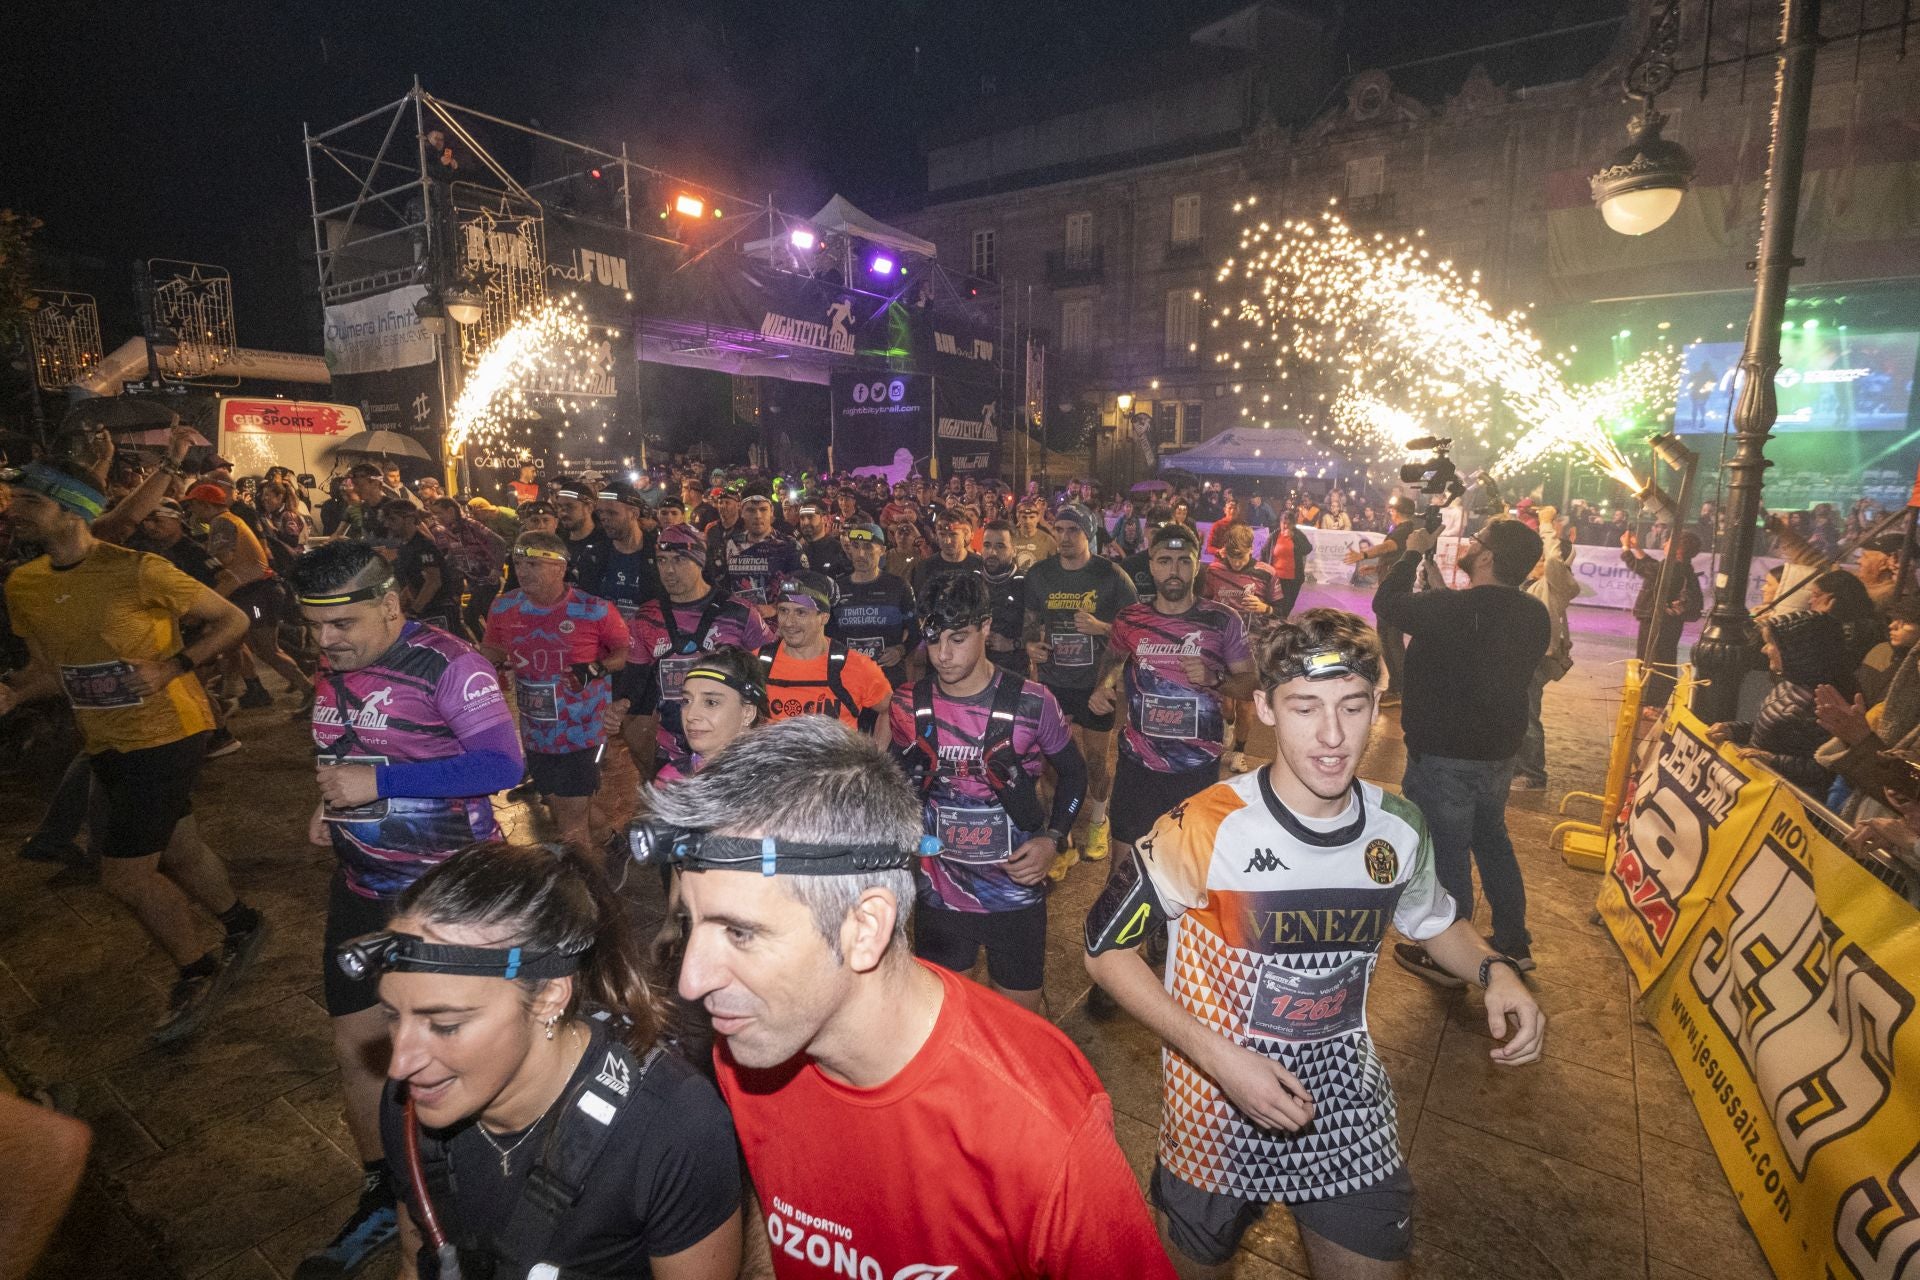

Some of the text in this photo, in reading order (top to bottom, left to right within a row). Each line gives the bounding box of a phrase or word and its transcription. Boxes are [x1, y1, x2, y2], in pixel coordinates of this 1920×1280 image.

[581, 248, 629, 290] FUN
[327, 321, 375, 341] Quimera
[761, 312, 856, 352] NIGHTCITY TRAIL
[843, 404, 920, 416] nightcitytrail.com
[938, 417, 982, 438] NIGHTCITY
[1049, 592, 1080, 600] adamo
[1136, 643, 1181, 655] NIGHTCITY
[357, 712, 389, 729] TRAIL
[1149, 708, 1184, 724] 1502
[1659, 727, 1746, 823] JESUS SAIZ
[947, 826, 993, 845] 1342
[1271, 988, 1347, 1020] 1262
[1255, 1021, 1294, 1033] cantabria
[1672, 993, 1793, 1224] www.jesussaiz.com
[773, 1196, 853, 1241] CLUB DEPORTIVO
[768, 1212, 884, 1280] OZONO
